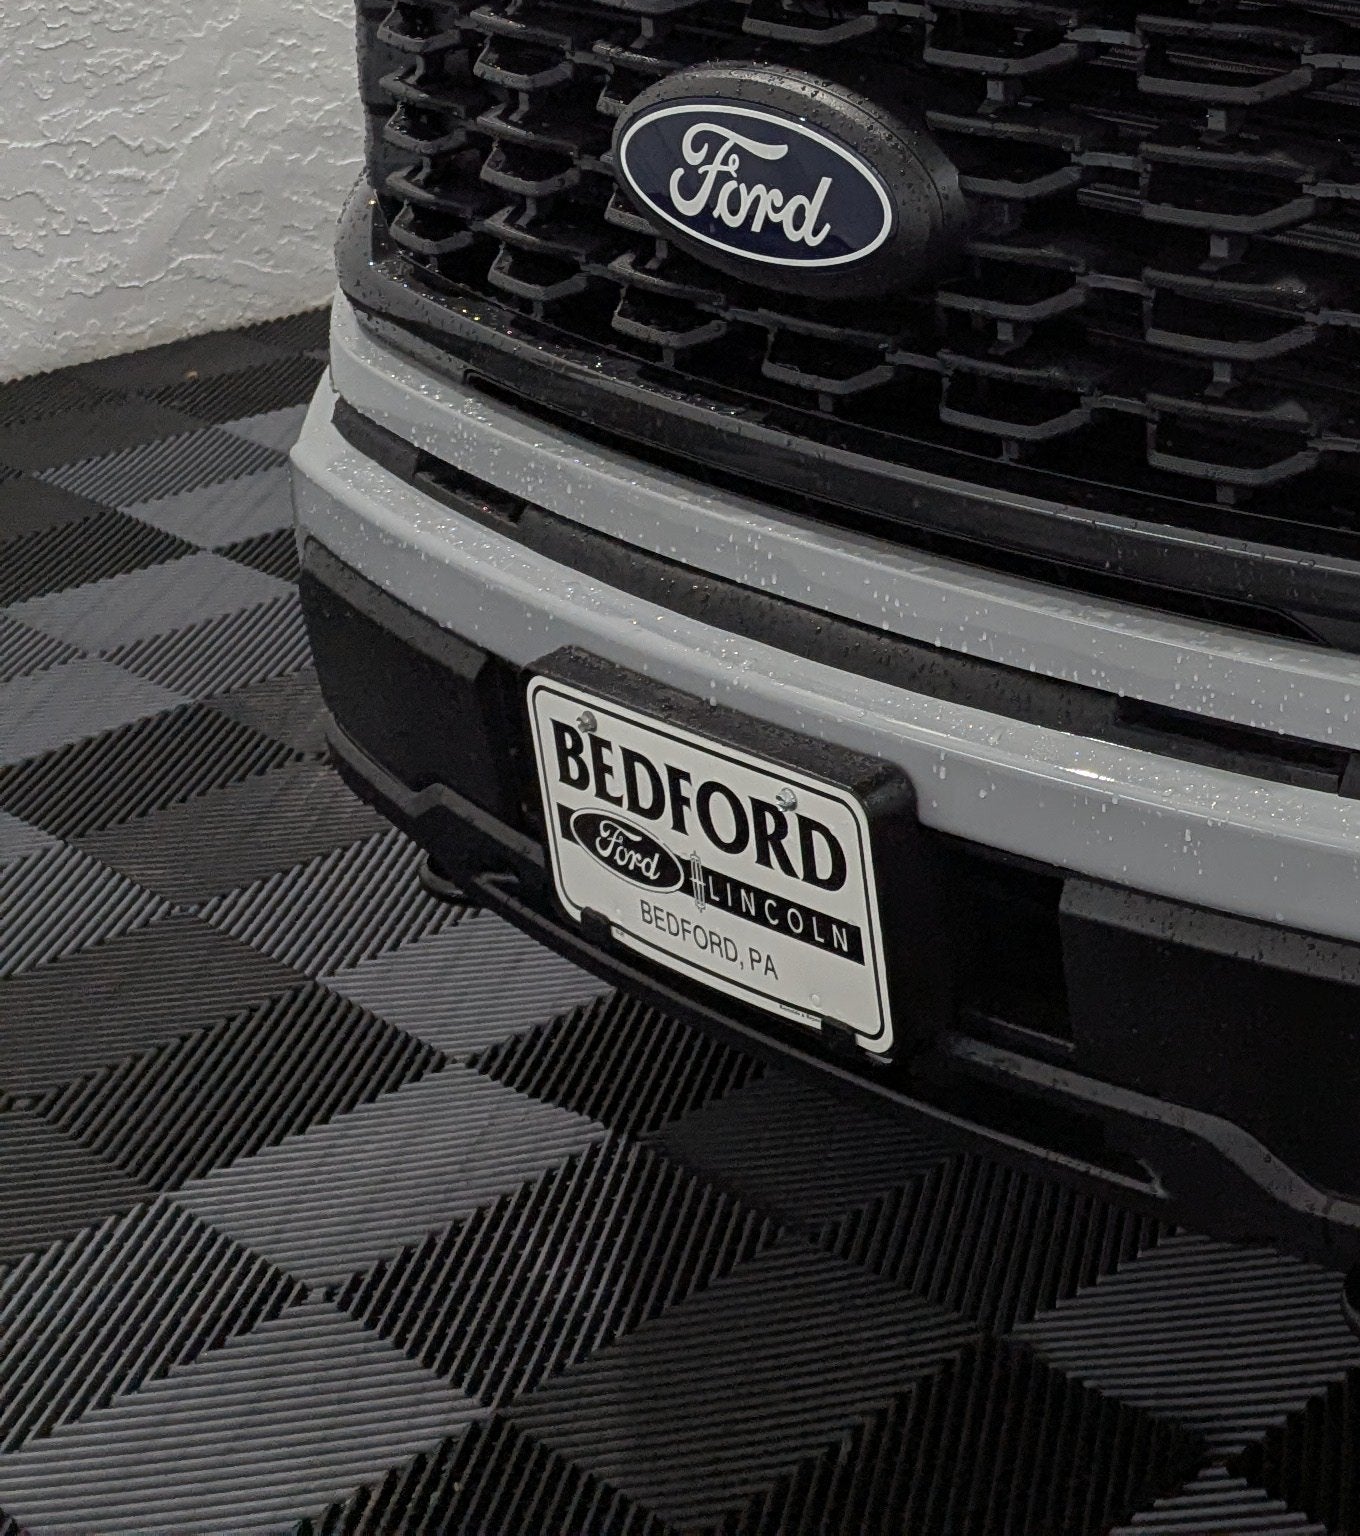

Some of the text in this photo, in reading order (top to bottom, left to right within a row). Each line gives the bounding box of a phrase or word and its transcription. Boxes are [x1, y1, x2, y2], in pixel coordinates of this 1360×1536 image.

[668, 122, 833, 247] Ford
[551, 718, 848, 892] BEDFORD
[595, 819, 661, 881] Ford
[639, 900, 779, 981] BEDFORD, PA
[708, 875, 849, 952] LINCOLN
